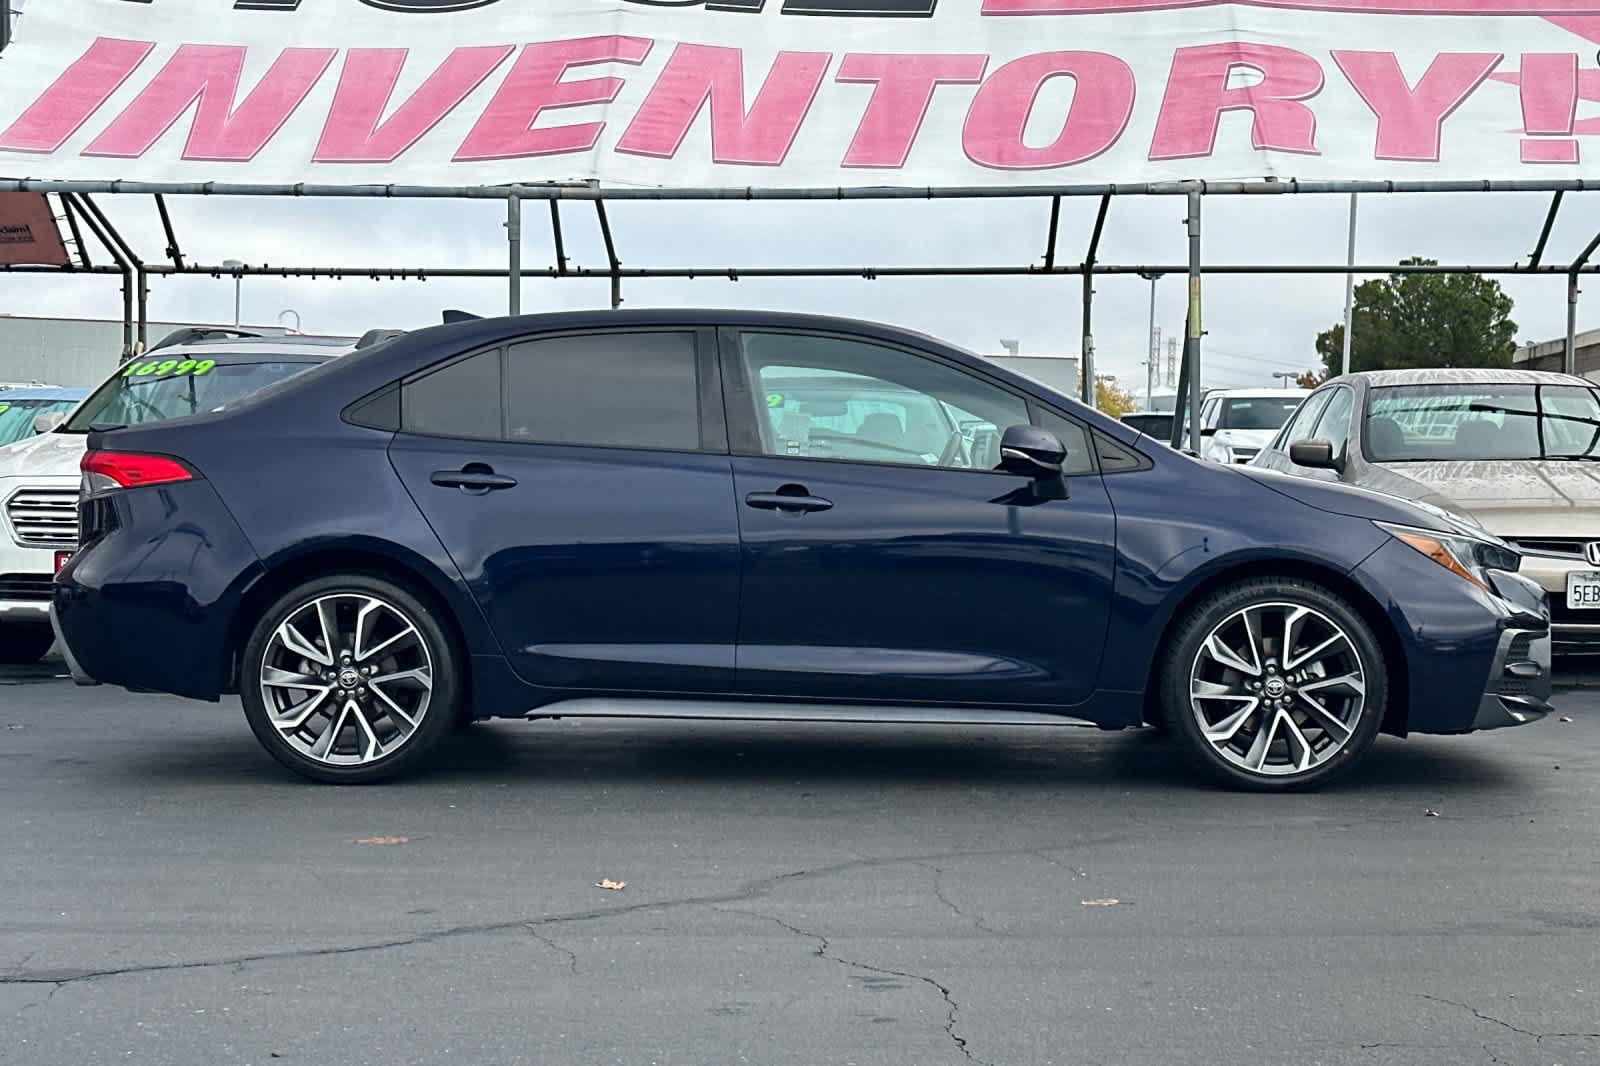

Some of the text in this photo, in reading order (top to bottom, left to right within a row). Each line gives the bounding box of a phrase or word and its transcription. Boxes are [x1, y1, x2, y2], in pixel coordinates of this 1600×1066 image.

[0, 36, 1580, 170] INVENTORY!
[122, 360, 215, 376] 16999
[1573, 585, 1600, 602] 5EB
